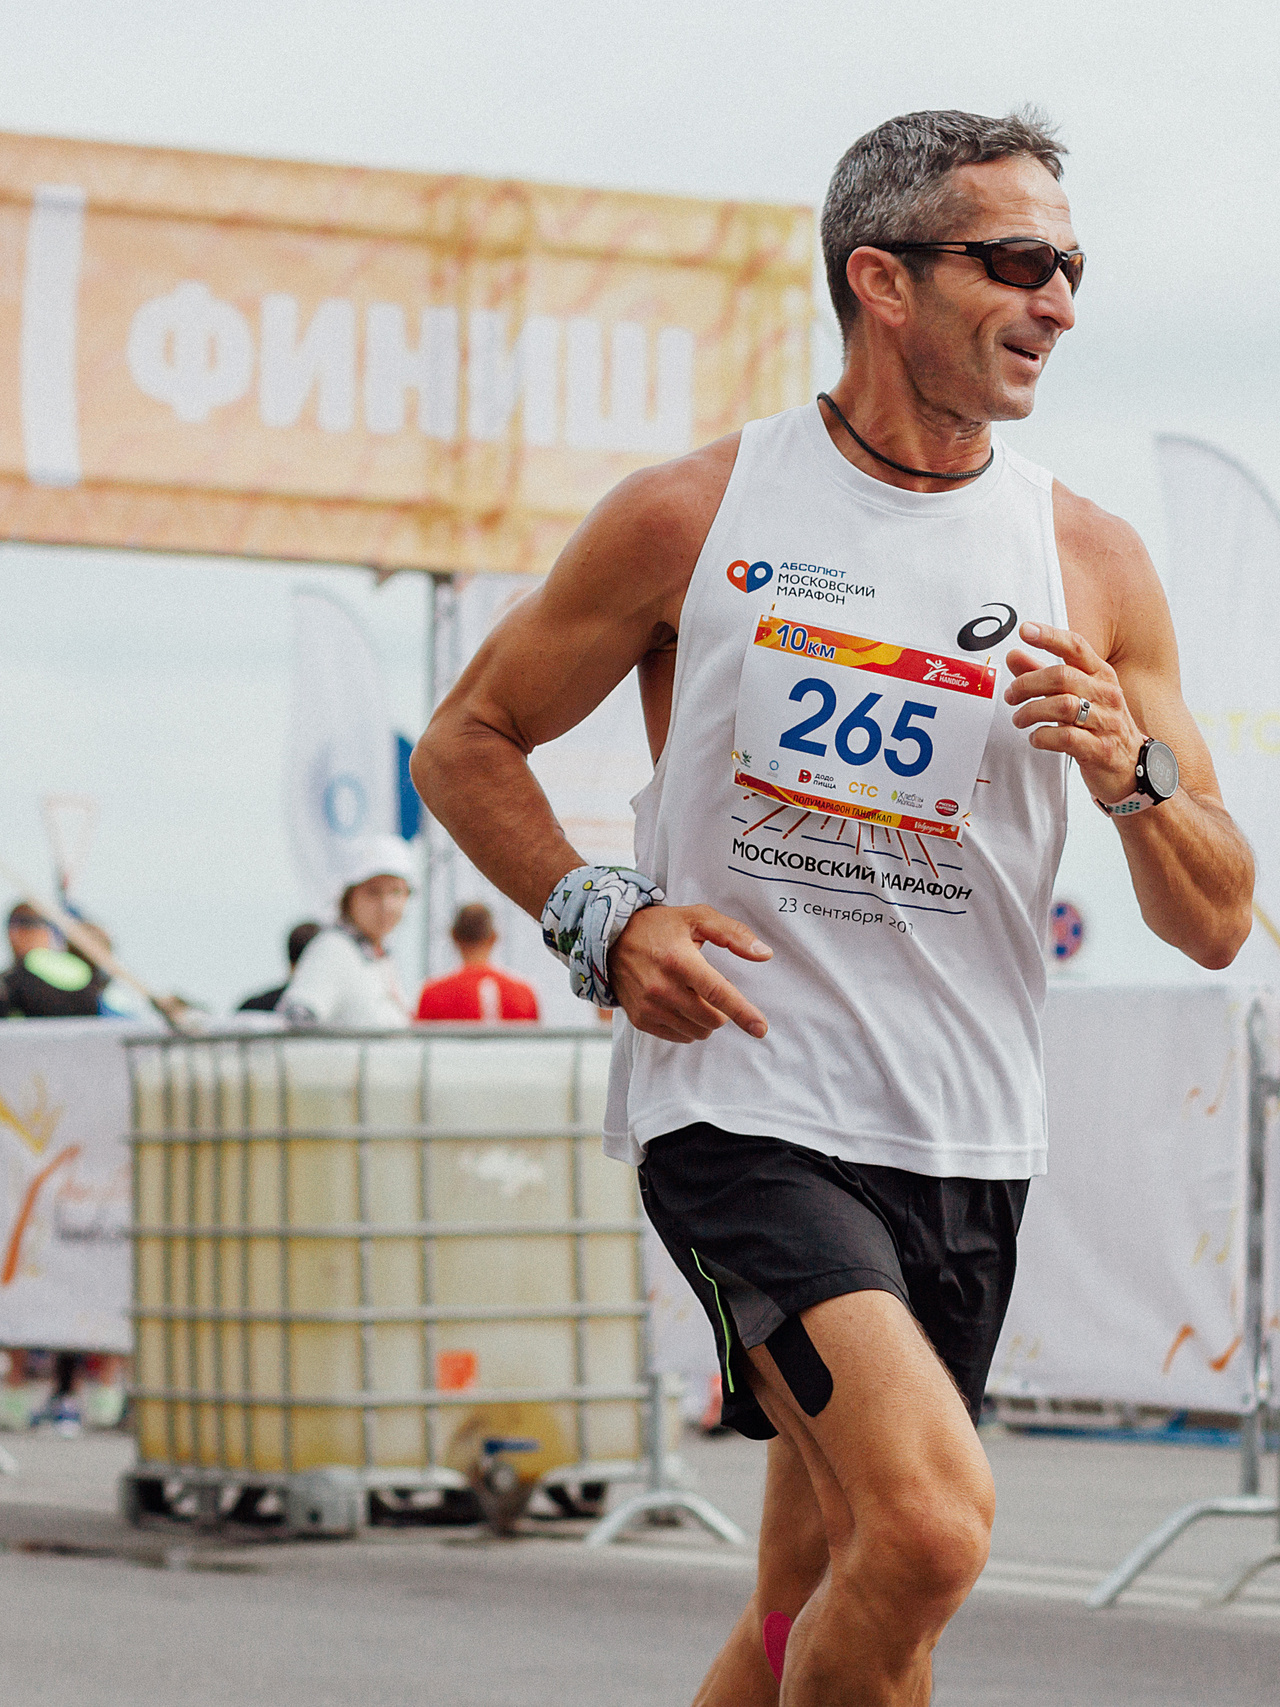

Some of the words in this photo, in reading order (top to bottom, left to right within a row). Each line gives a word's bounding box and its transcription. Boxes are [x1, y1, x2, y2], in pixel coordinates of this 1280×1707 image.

[126, 279, 696, 453] ФИНИШ
[780, 562, 847, 579] АБСОЛЮТ
[776, 585, 846, 605] МАРАФОН
[778, 573, 876, 598] МОСКОВСКИЙ
[939, 675, 970, 688] HANDICAP
[778, 677, 938, 777] 265
[848, 781, 879, 798] СТС
[792, 794, 851, 815] ПОЛУМАРАФОН
[851, 807, 893, 824] ГАНДИКАП
[732, 838, 876, 884] МОСКОВСКИЙ
[880, 871, 973, 901] МАРАФОН
[777, 896, 797, 914] 23
[803, 902, 884, 925] сентября
